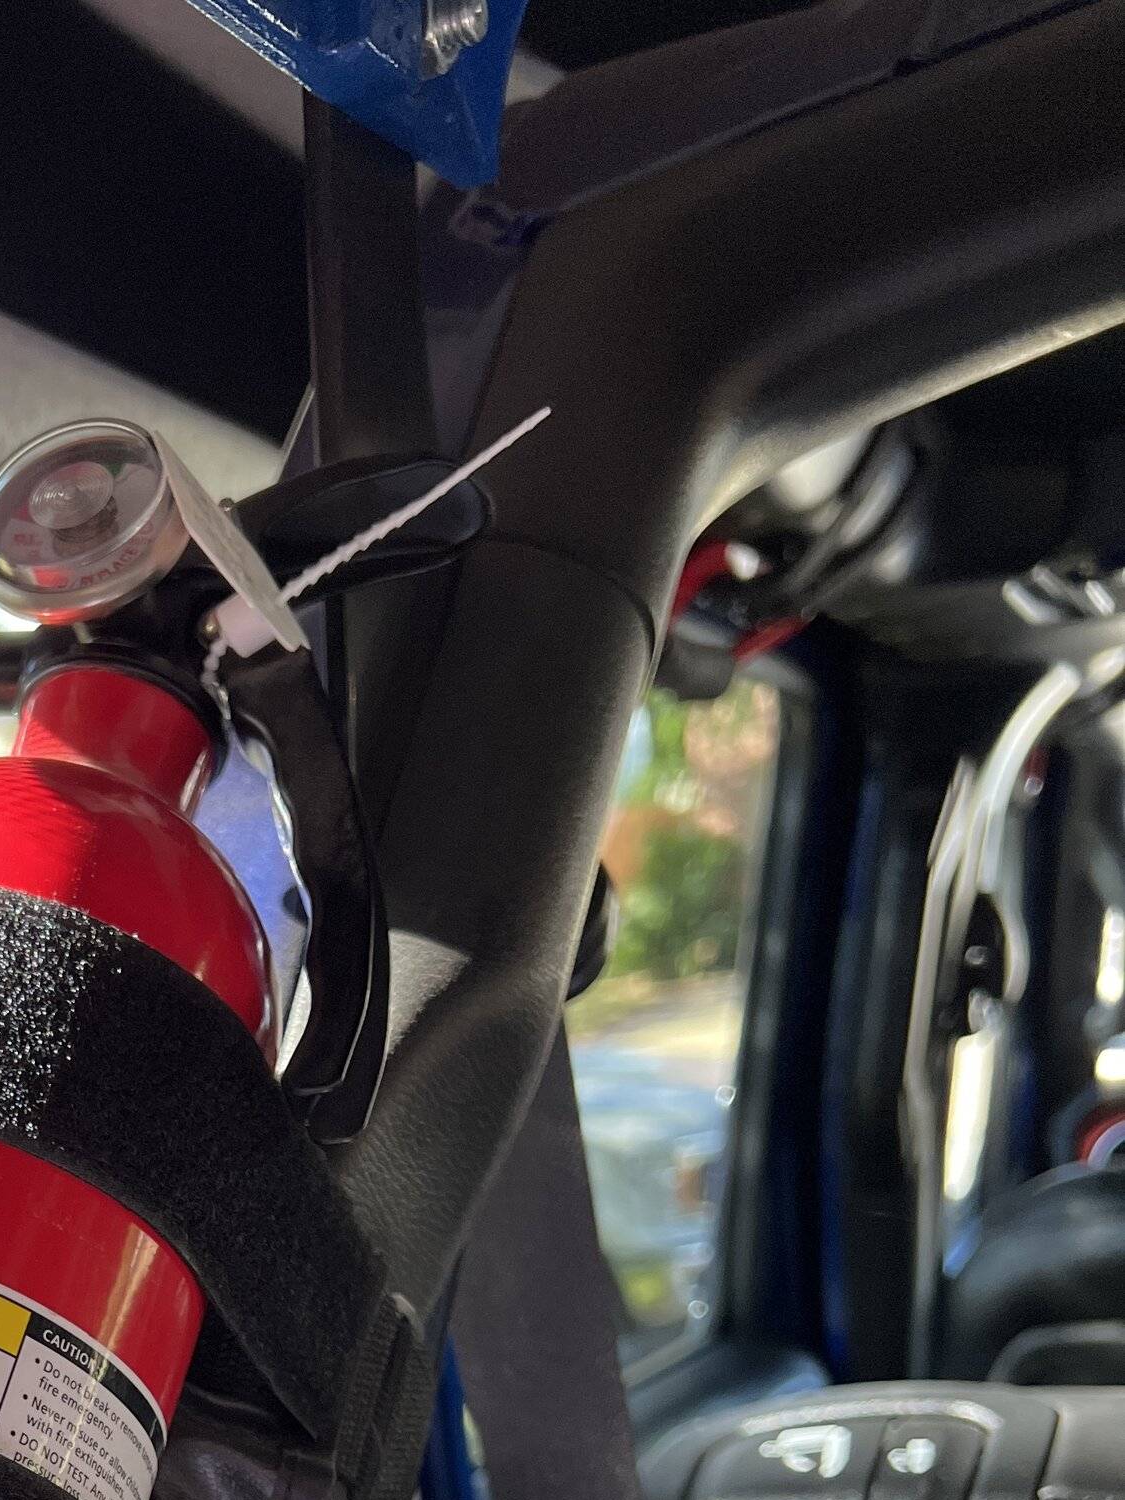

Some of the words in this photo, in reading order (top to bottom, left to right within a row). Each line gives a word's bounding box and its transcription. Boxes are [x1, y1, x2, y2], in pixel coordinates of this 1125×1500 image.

[38, 1375, 60, 1397] fire
[43, 1360, 61, 1379] Do
[62, 1373, 83, 1394] not
[83, 1387, 110, 1417] break
[110, 1411, 121, 1424] or
[26, 1413, 54, 1438] with
[54, 1429, 74, 1450] fire
[31, 1396, 66, 1426] Never
[99, 1446, 109, 1460] or
[108, 1455, 127, 1481] allow
[18, 1432, 39, 1451] DO
[41, 1444, 66, 1469] NOT
